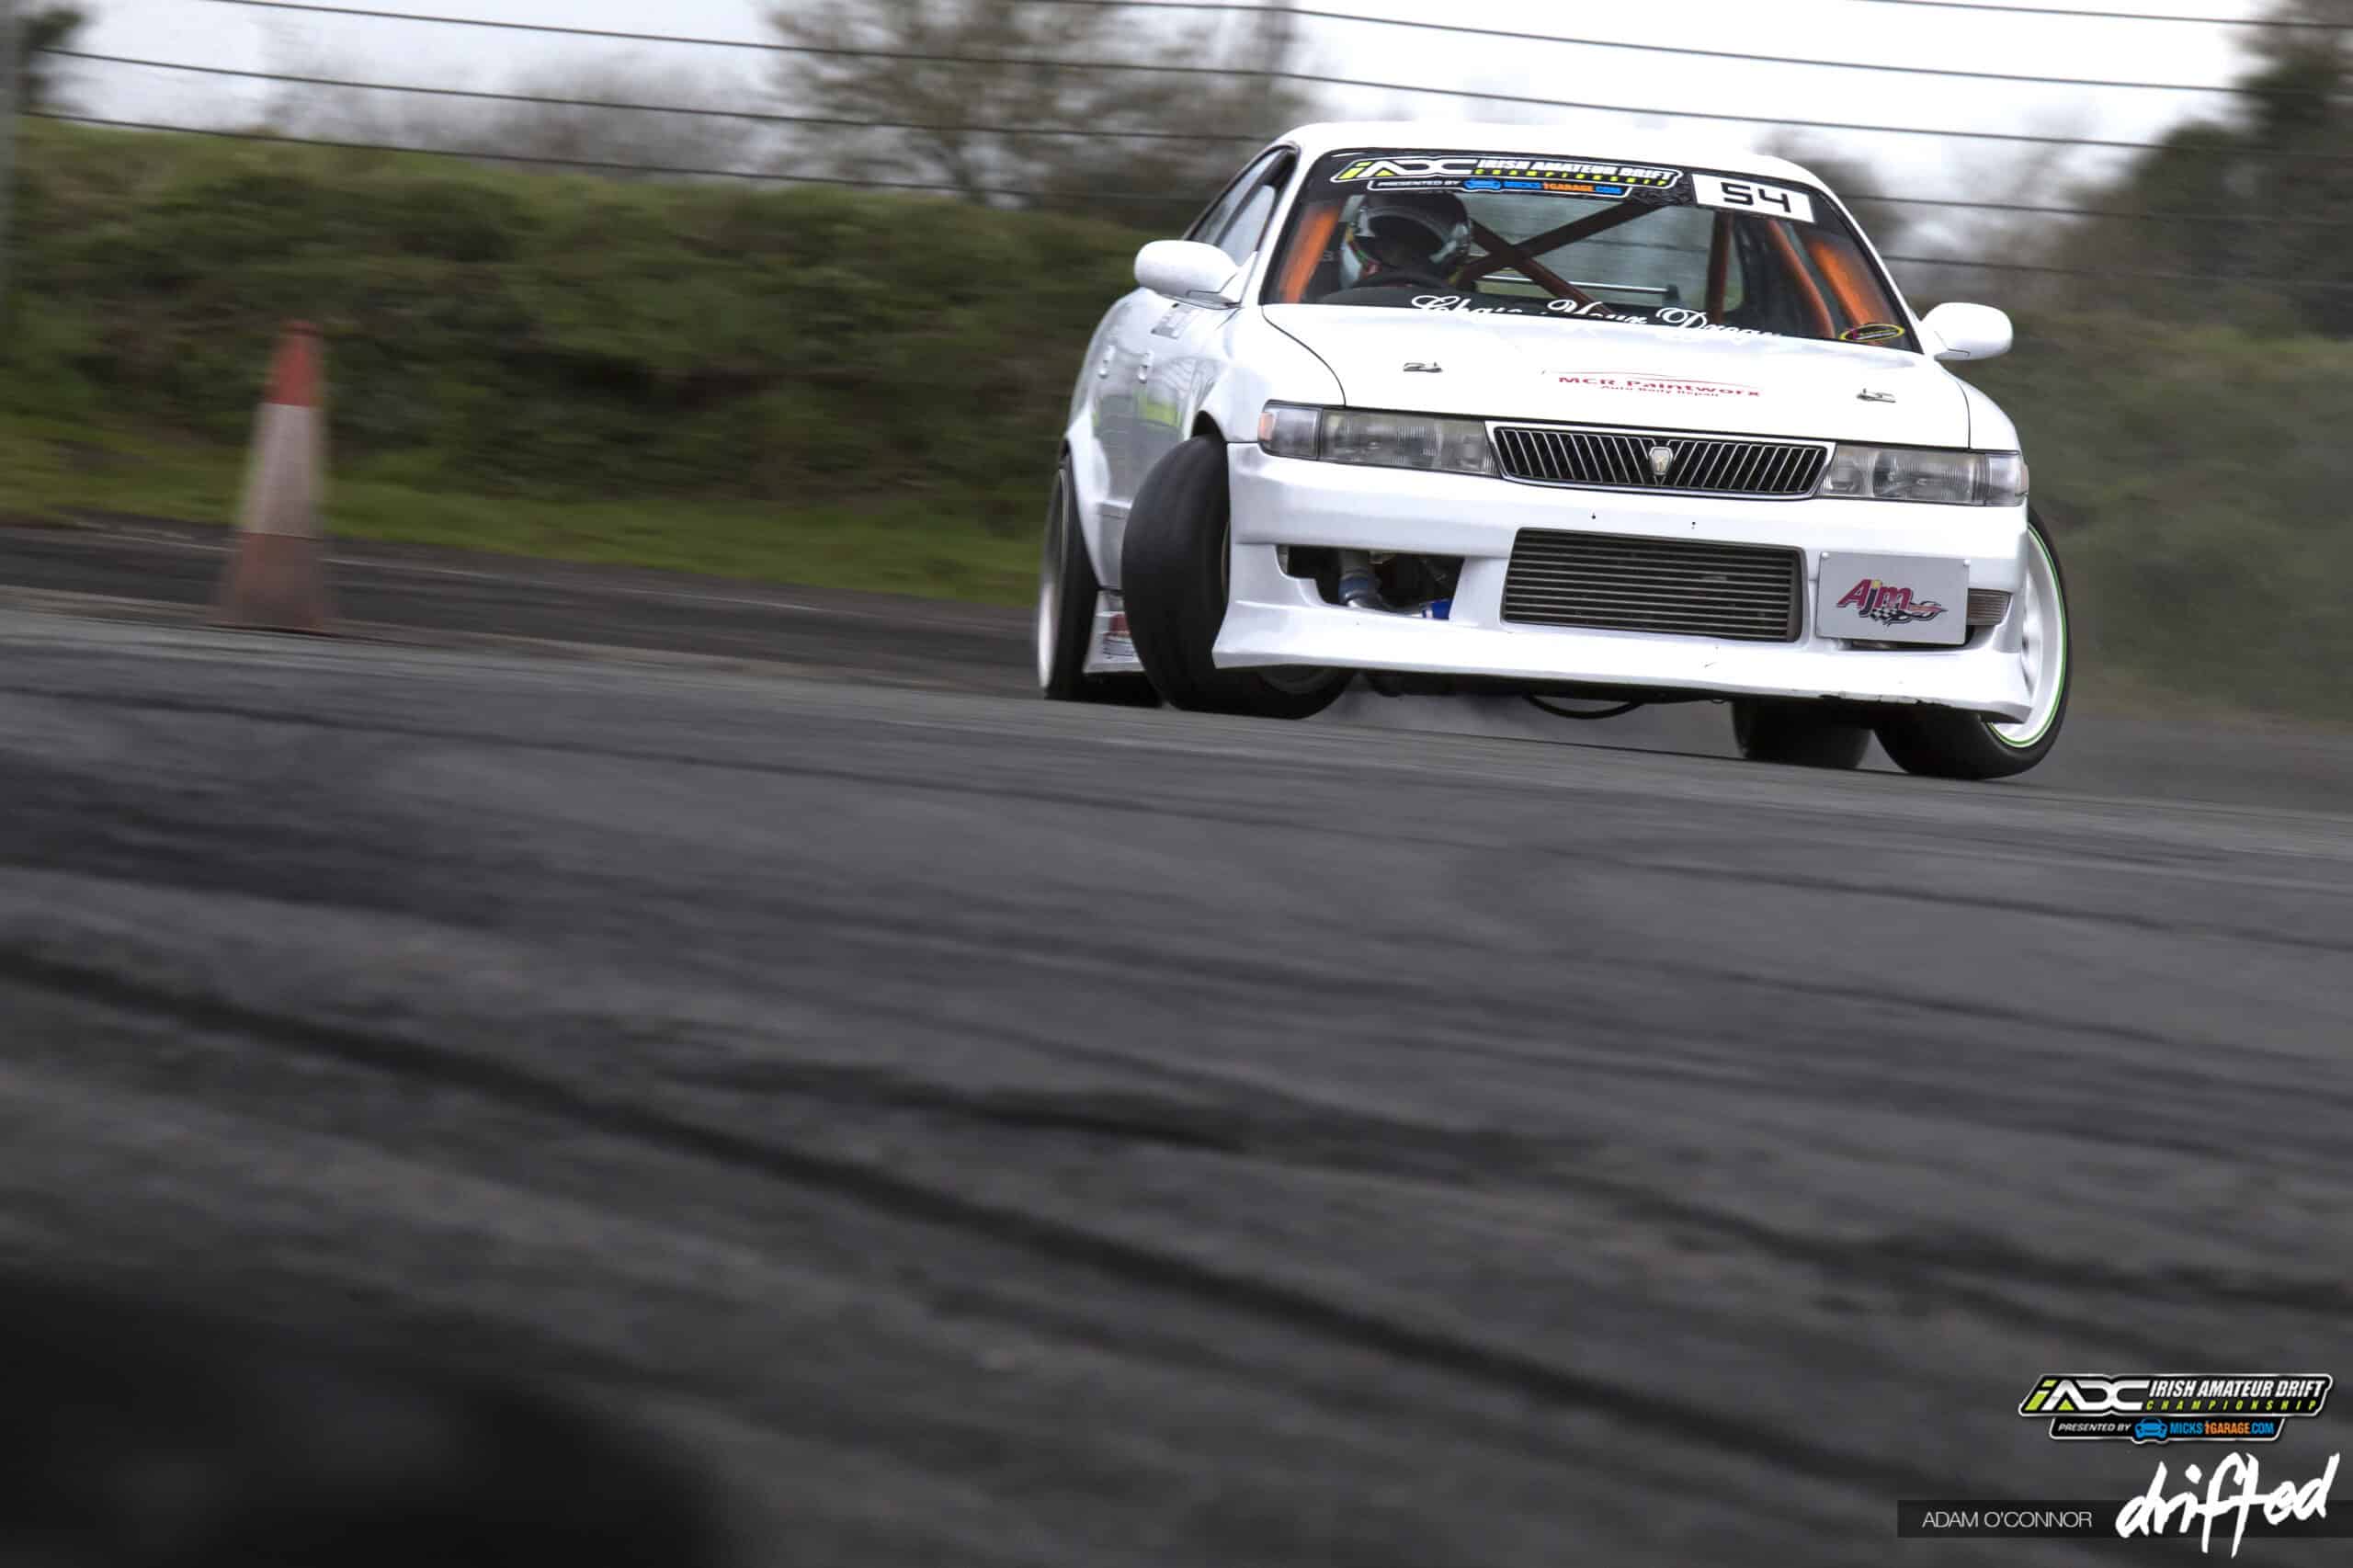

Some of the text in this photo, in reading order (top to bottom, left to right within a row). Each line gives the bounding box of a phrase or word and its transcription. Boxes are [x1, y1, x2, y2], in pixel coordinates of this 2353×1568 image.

[1477, 159, 1676, 180] IRISH AMATEUR DRIFT
[1721, 182, 1791, 213] 54
[1559, 377, 1616, 385] MCR
